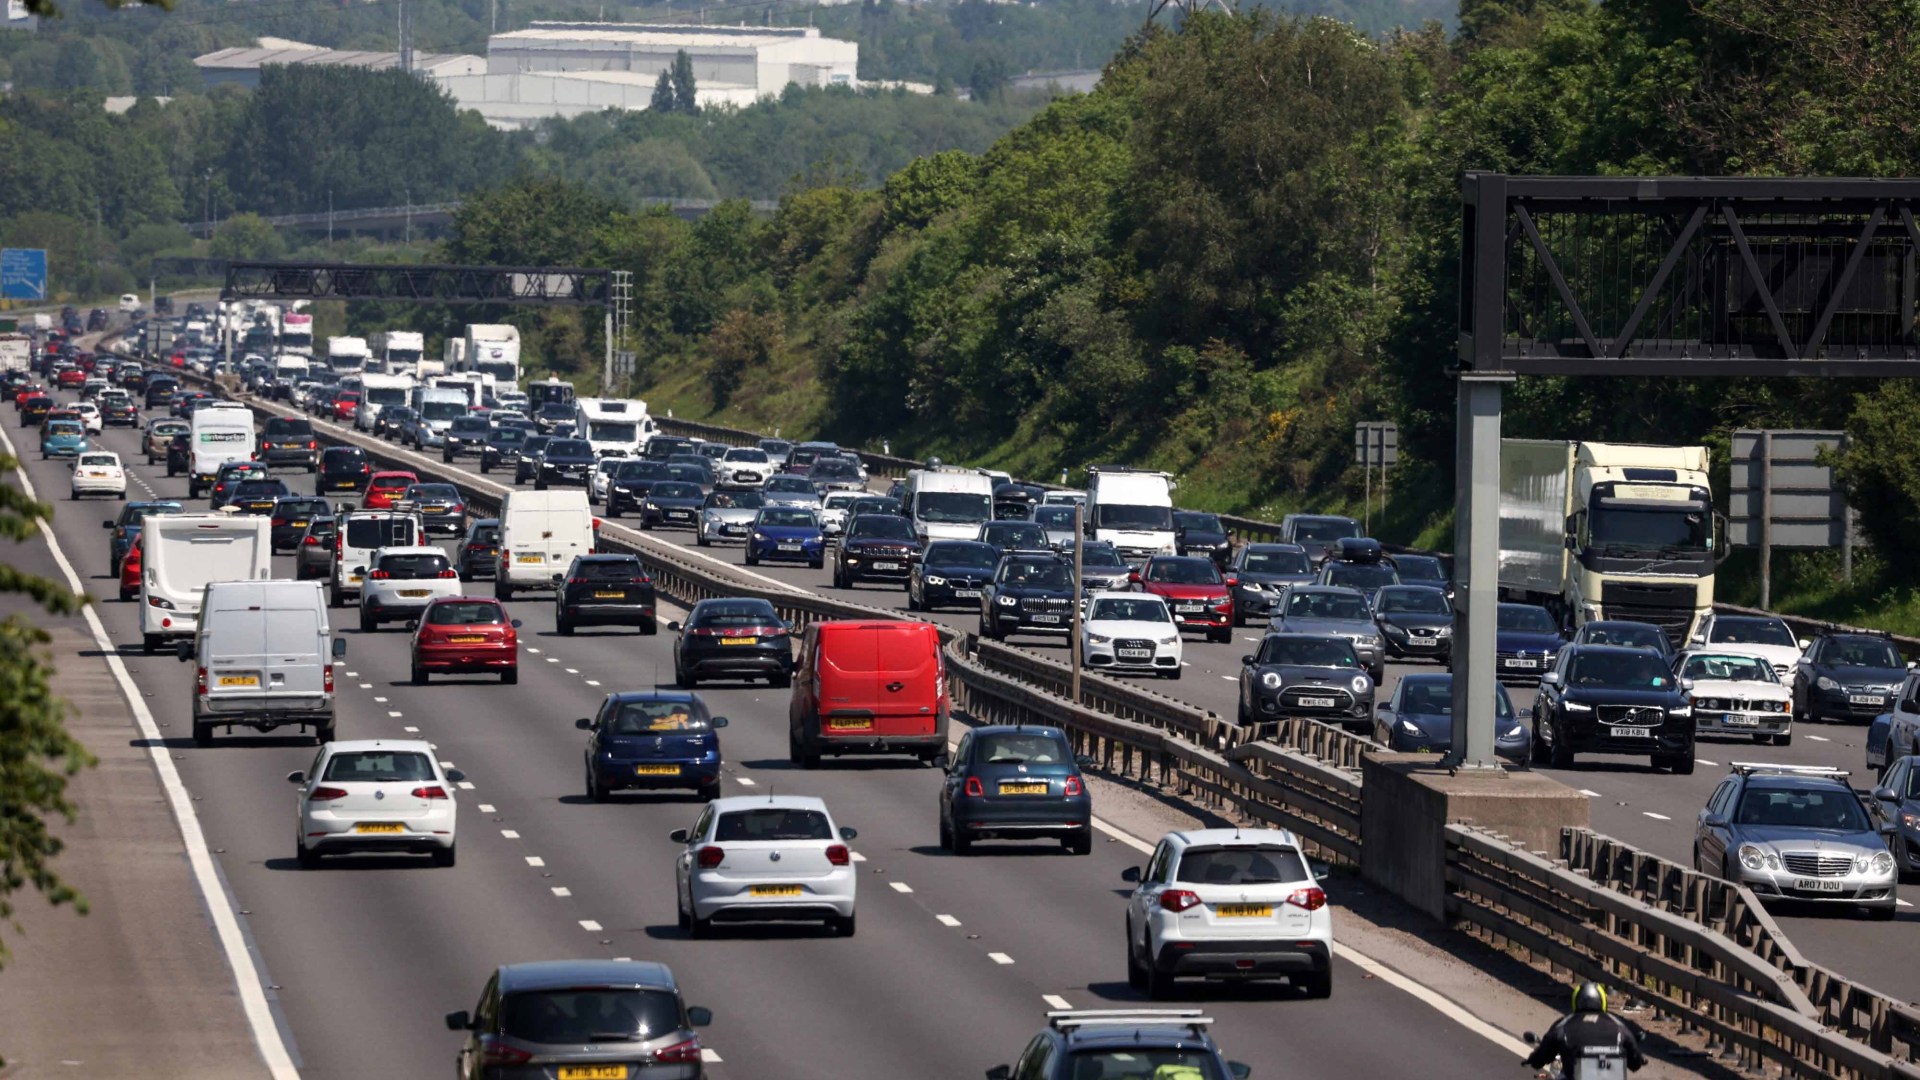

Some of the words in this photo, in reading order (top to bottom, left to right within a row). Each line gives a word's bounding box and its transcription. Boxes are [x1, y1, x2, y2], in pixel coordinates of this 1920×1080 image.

[201, 433, 245, 443] enterprise
[1616, 727, 1631, 735] YX18
[1632, 727, 1646, 735] KBU
[1798, 879, 1821, 889] AR07
